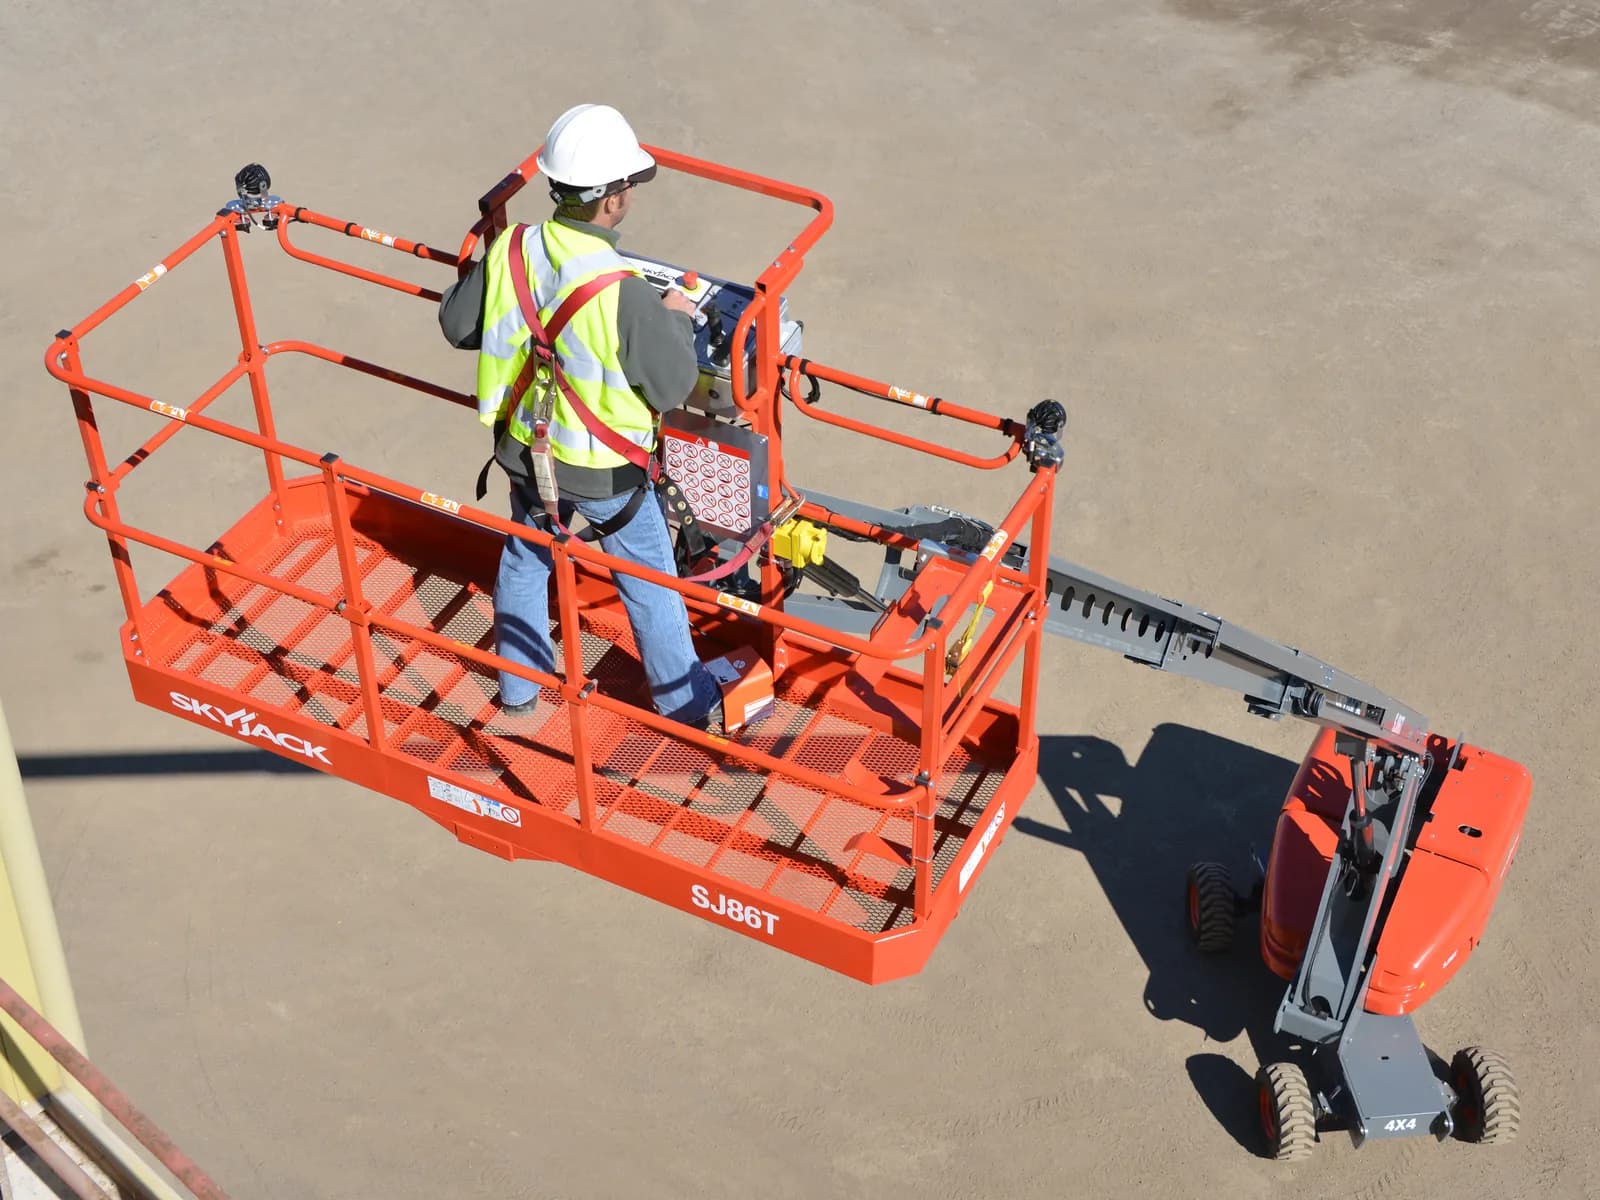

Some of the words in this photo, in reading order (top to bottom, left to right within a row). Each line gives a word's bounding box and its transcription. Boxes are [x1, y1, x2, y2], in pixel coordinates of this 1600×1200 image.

[169, 691, 333, 766] SKYJACK
[691, 884, 780, 936] SJ86T
[1383, 1118, 1417, 1131] 4X4
